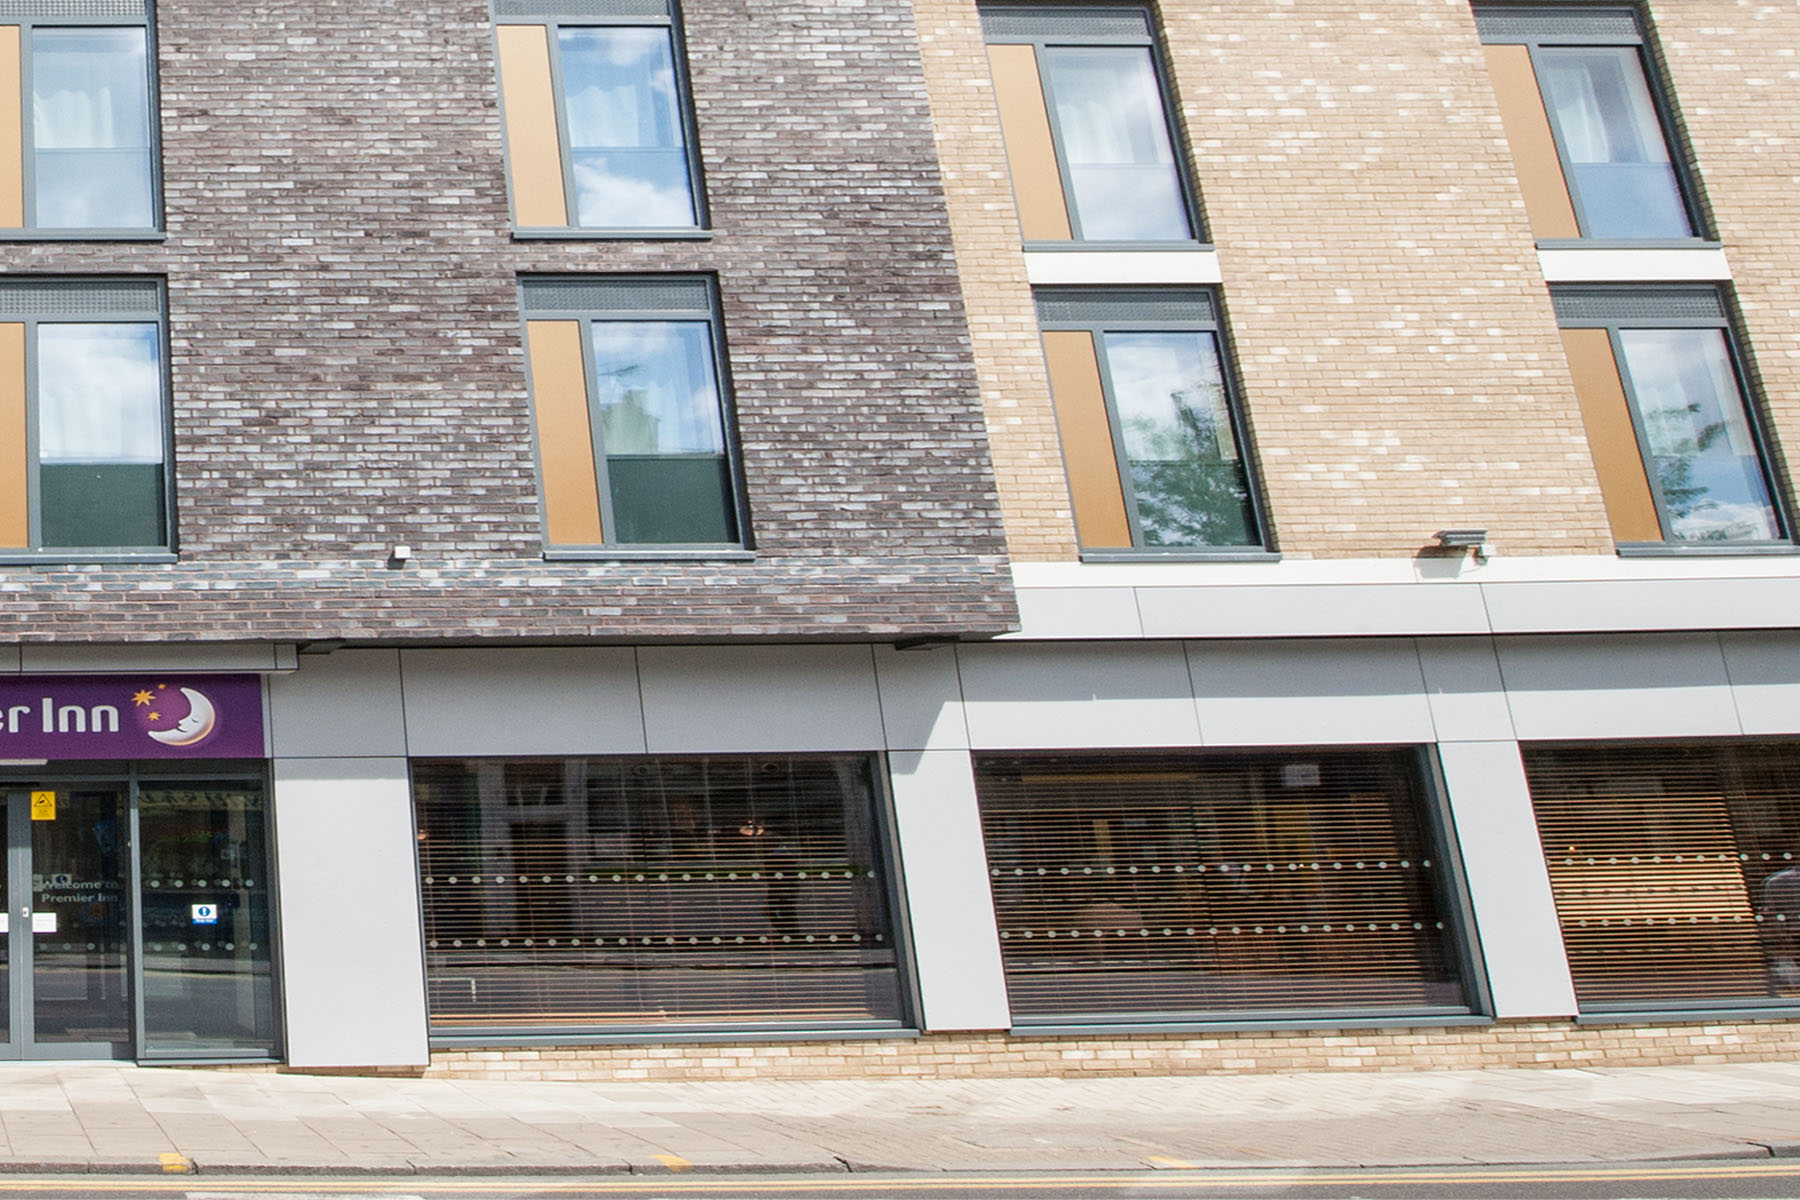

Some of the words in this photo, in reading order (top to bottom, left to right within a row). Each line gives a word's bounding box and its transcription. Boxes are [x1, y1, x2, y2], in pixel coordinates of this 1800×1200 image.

[42, 697, 120, 733] Inn
[41, 892, 95, 903] Premier
[98, 892, 118, 903] Inn
